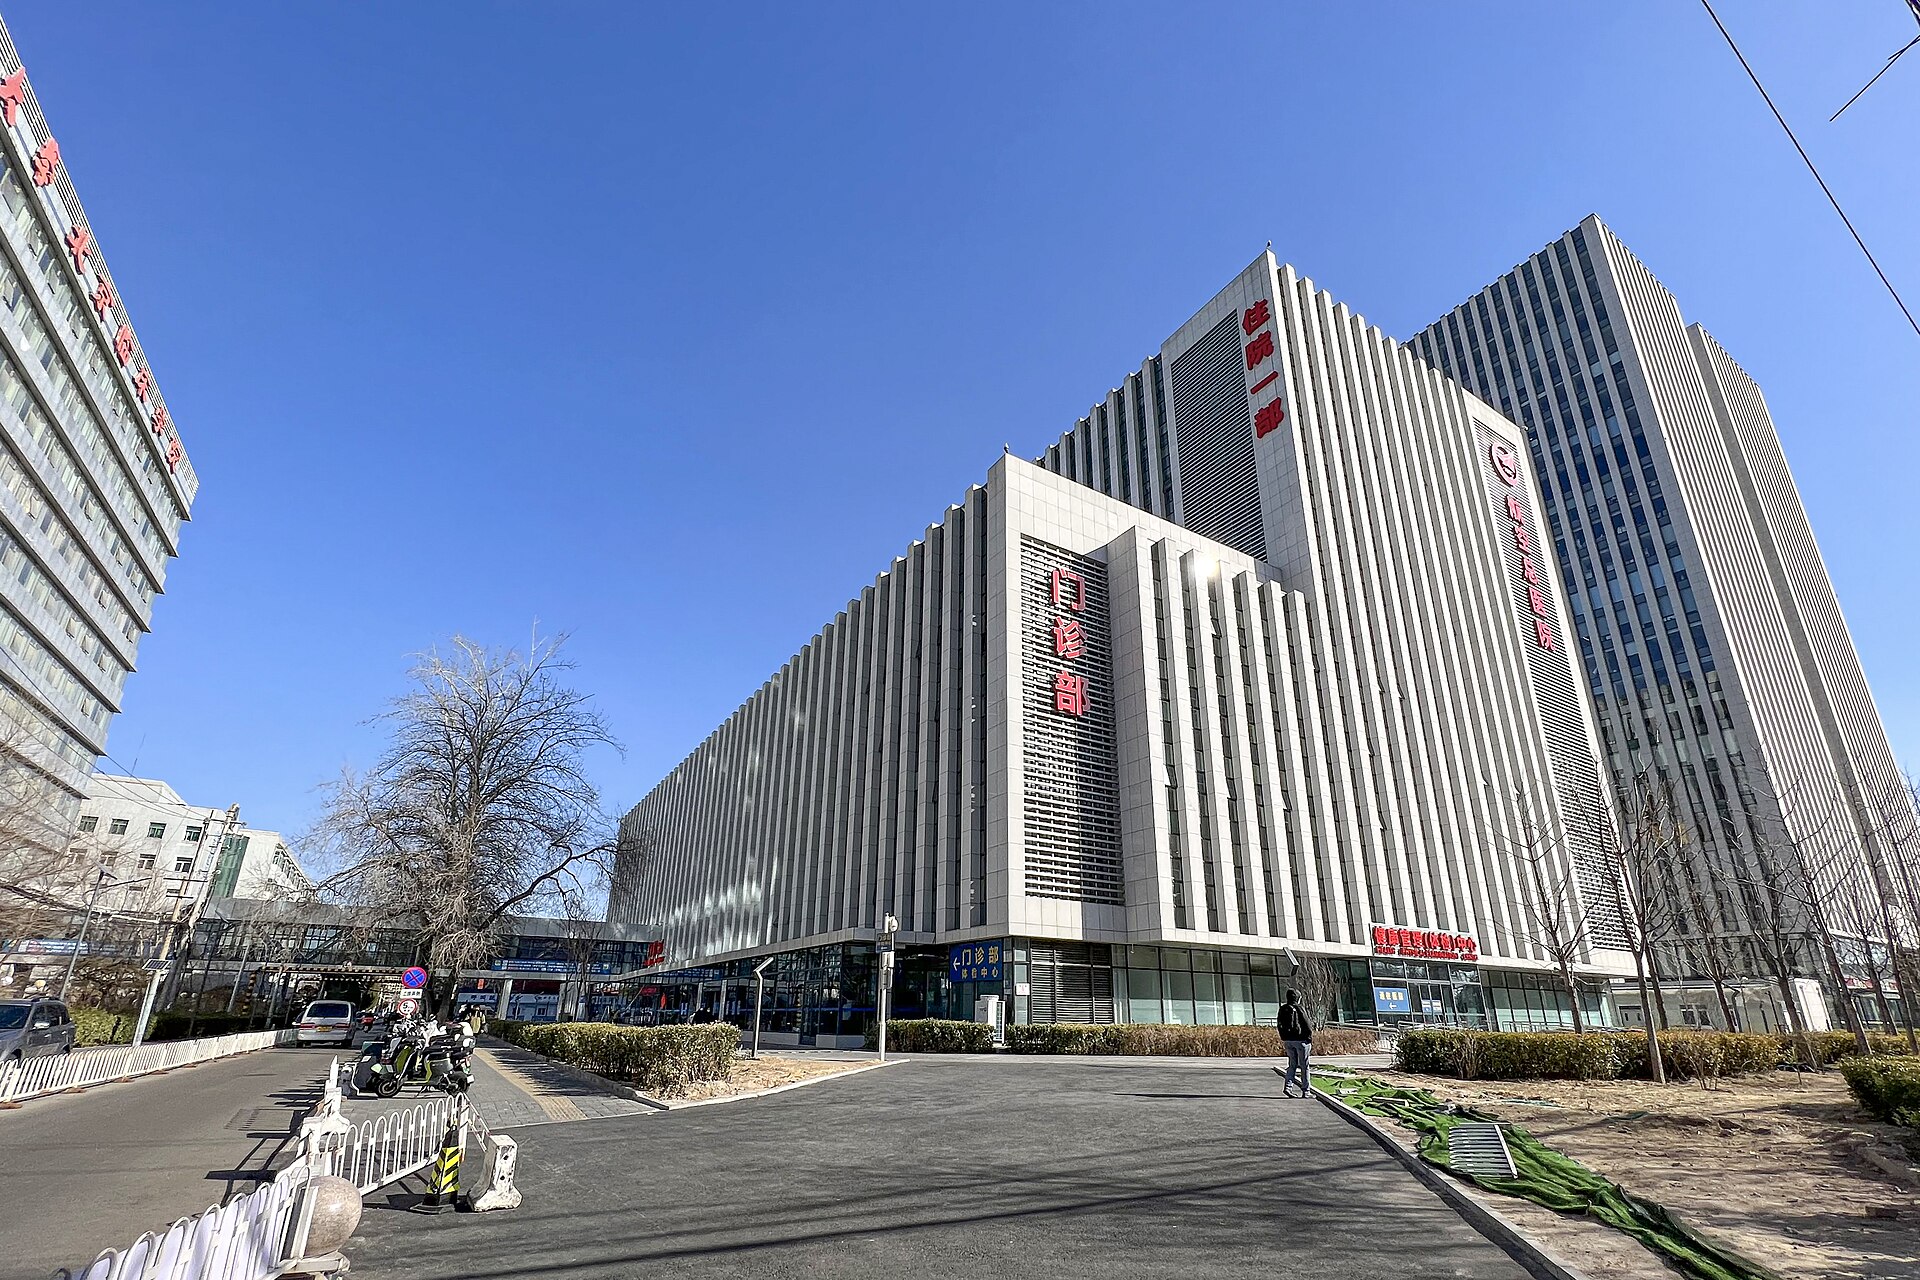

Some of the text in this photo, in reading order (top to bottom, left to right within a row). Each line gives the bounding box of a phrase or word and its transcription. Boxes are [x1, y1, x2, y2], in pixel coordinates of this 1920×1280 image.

[1242, 298, 1284, 439] 住院一部
[1051, 566, 1091, 717] 门诊部
[961, 967, 998, 979] 体检中心
[962, 945, 999, 966] 门诊部
